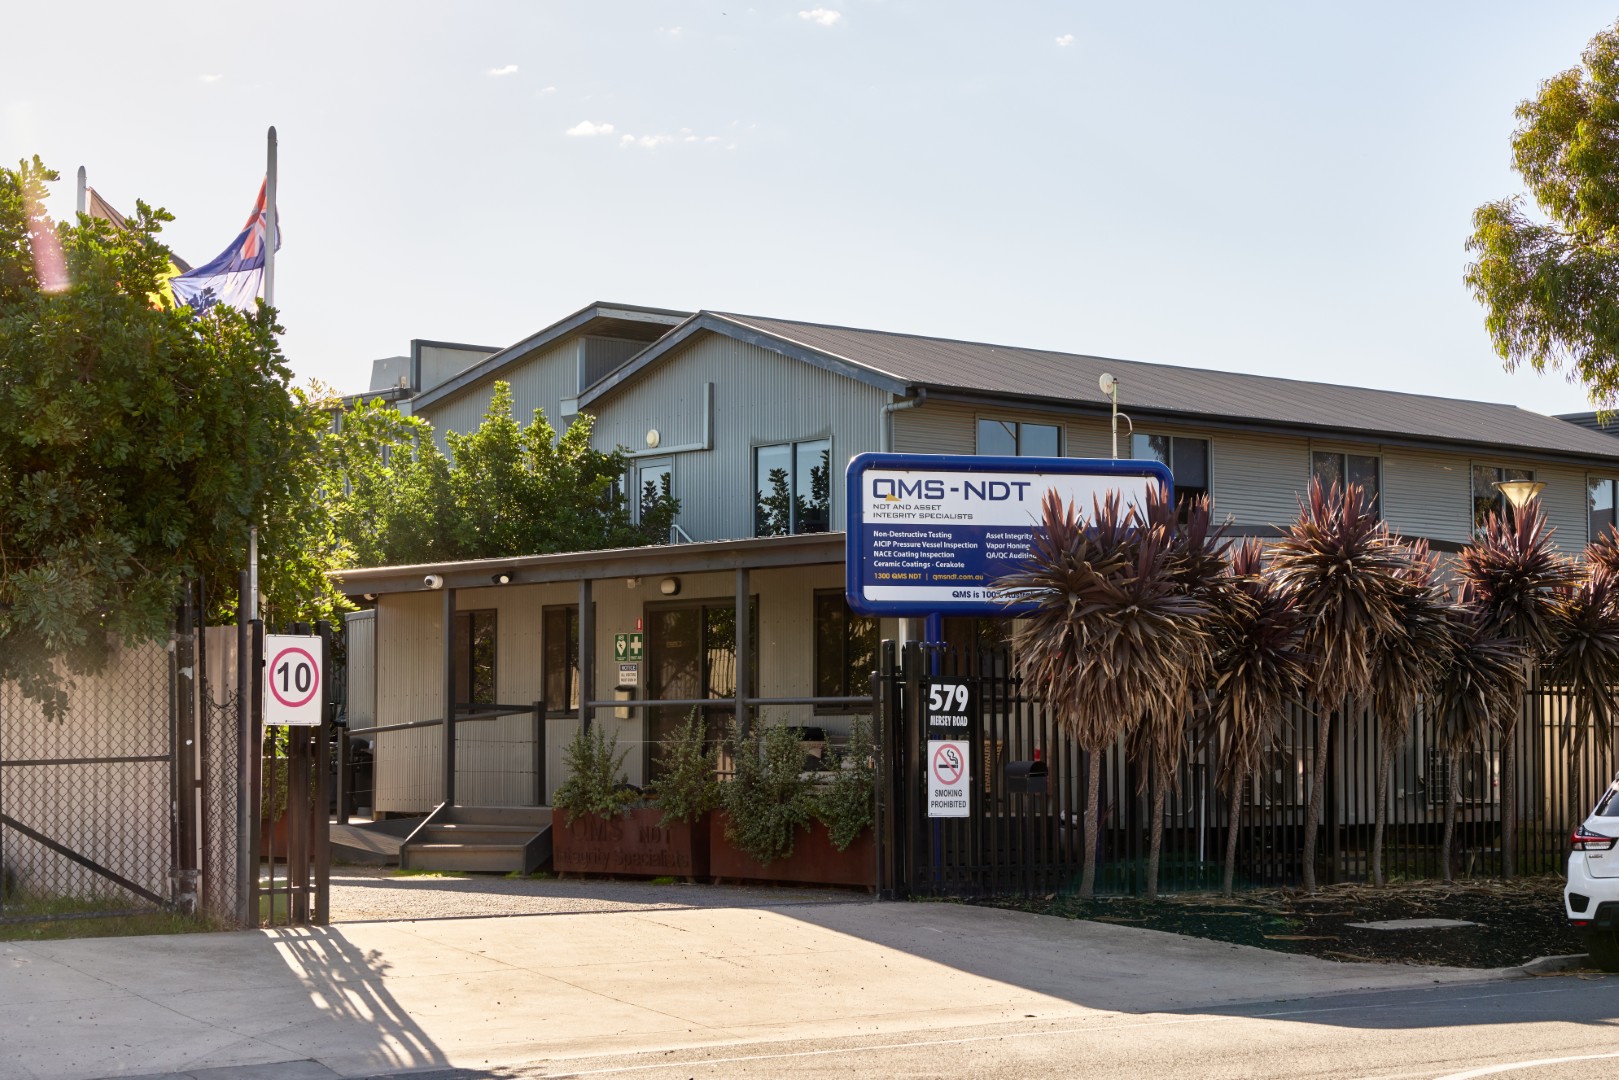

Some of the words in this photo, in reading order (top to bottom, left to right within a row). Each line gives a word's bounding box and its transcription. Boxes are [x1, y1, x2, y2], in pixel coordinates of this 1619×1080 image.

[873, 503, 890, 511] NDT
[873, 530, 927, 538] Non-Destructive
[928, 531, 952, 540] Testing
[985, 532, 1004, 540] Asset
[1004, 532, 1033, 541] Integrity
[873, 540, 891, 548] AICIP
[943, 541, 978, 550] Inspection
[986, 542, 1005, 550] Vapor
[873, 550, 892, 558] NACE
[893, 550, 919, 559] Coating
[920, 551, 954, 560] Inspection
[985, 551, 1009, 560] QA/QC
[873, 560, 901, 568] Ceramic
[901, 561, 931, 569] Coatings
[932, 573, 984, 581] qmsndt.com.au
[951, 590, 972, 599] QMS
[972, 590, 980, 599] is
[277, 661, 311, 692] 10
[928, 683, 969, 712] 579
[929, 714, 952, 727] MERSEY
[952, 715, 968, 727] ROAD
[934, 789, 963, 797] SMOKING
[930, 800, 967, 808] PROHIBITED
